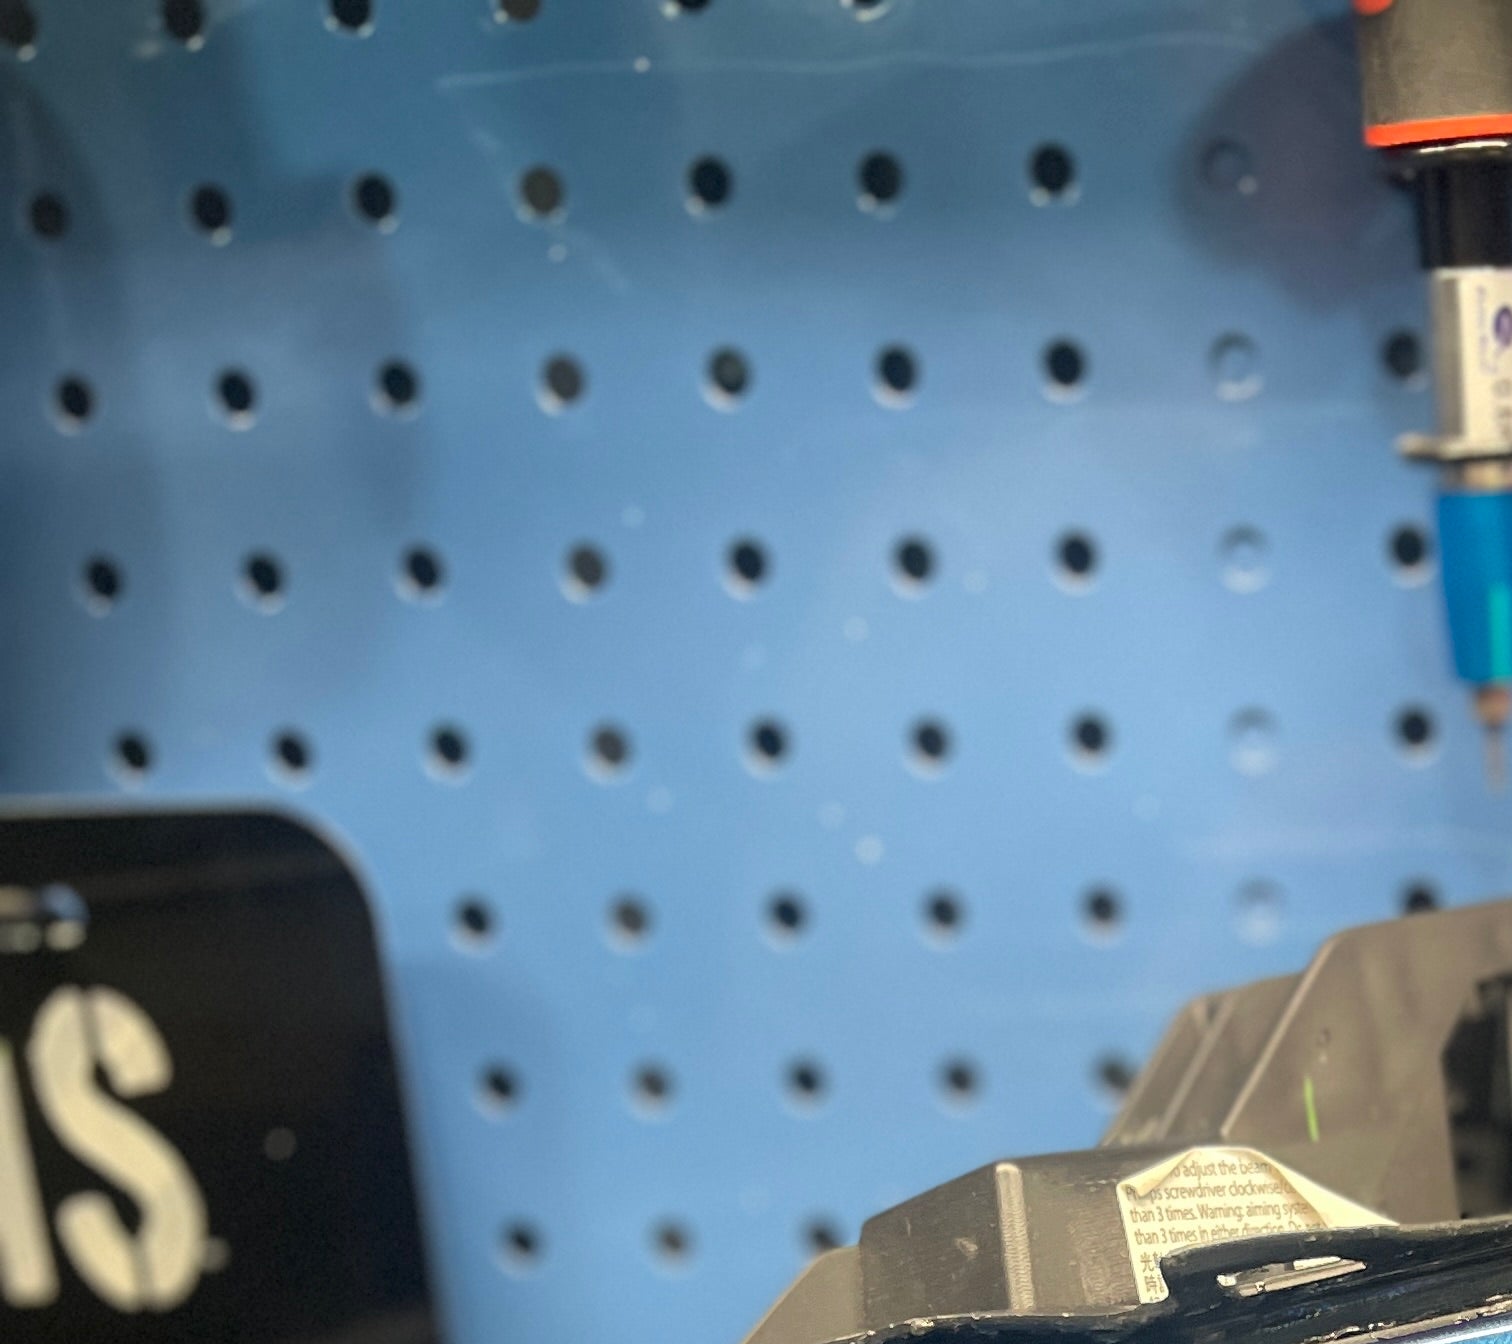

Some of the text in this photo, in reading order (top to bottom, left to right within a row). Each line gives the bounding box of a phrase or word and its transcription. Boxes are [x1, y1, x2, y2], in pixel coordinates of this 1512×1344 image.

[1183, 1160, 1216, 1181] adjust
[1218, 1160, 1237, 1175] the
[1165, 1182, 1226, 1200] screwdriver
[1130, 1208, 1155, 1223] than
[1156, 1206, 1164, 1222] 3
[1246, 1201, 1281, 1219] aiming
[1134, 1228, 1159, 1245] than
[1160, 1227, 1168, 1244] 3
[1169, 1226, 1198, 1243] times
[1198, 1225, 1209, 1242] in
